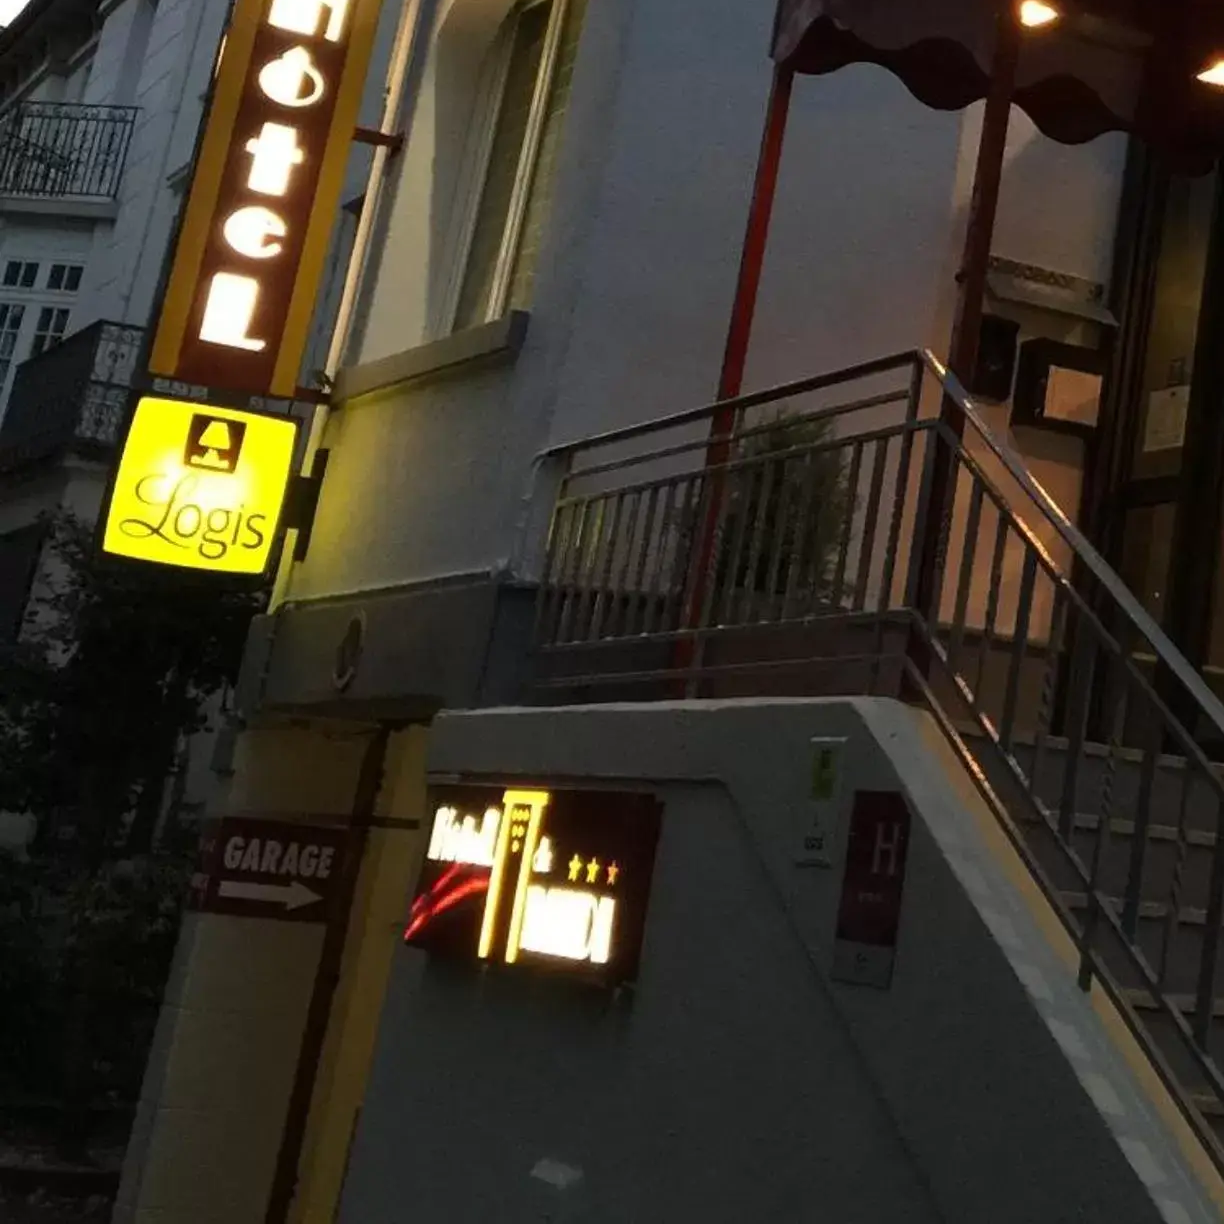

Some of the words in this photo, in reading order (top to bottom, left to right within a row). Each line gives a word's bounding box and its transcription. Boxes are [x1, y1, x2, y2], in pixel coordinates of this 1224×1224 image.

[119, 473, 266, 559] Logis
[223, 836, 336, 879] GARAGE
[871, 821, 901, 876] H
